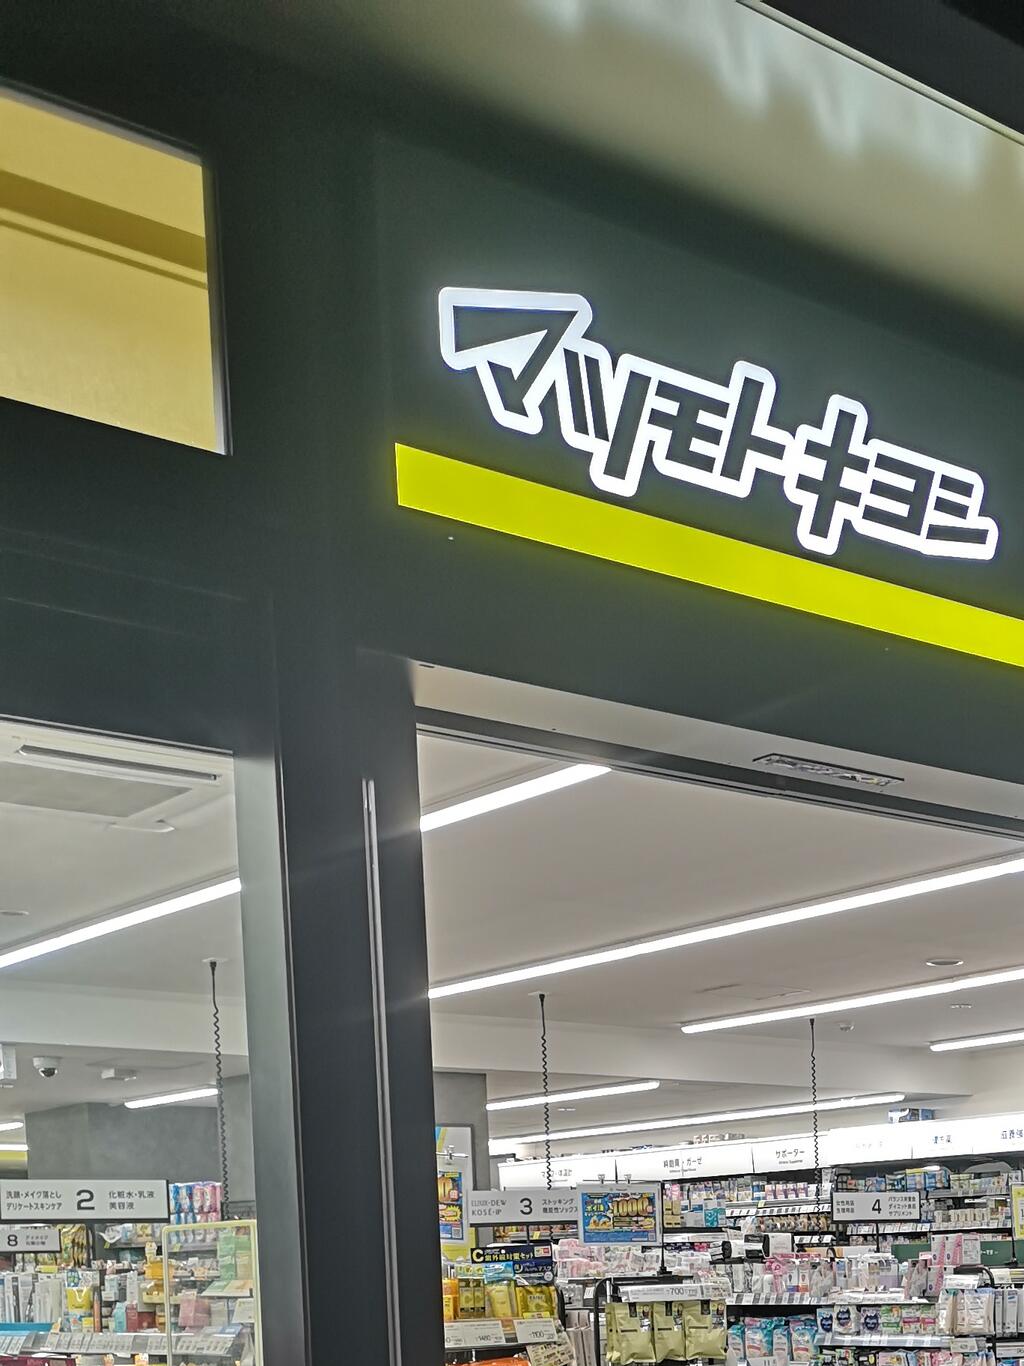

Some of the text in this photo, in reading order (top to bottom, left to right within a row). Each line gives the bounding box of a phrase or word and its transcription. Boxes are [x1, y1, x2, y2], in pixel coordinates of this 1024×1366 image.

[439, 287, 999, 561] マツモトキヨシ
[775, 1148, 806, 1159] サポーター
[76, 1189, 95, 1211] 2
[108, 1190, 156, 1200] 化粧水・乳液
[109, 1201, 135, 1211] 美容液
[520, 1197, 533, 1216] 3
[871, 1198, 882, 1215] 4
[7, 1234, 18, 1247] 8
